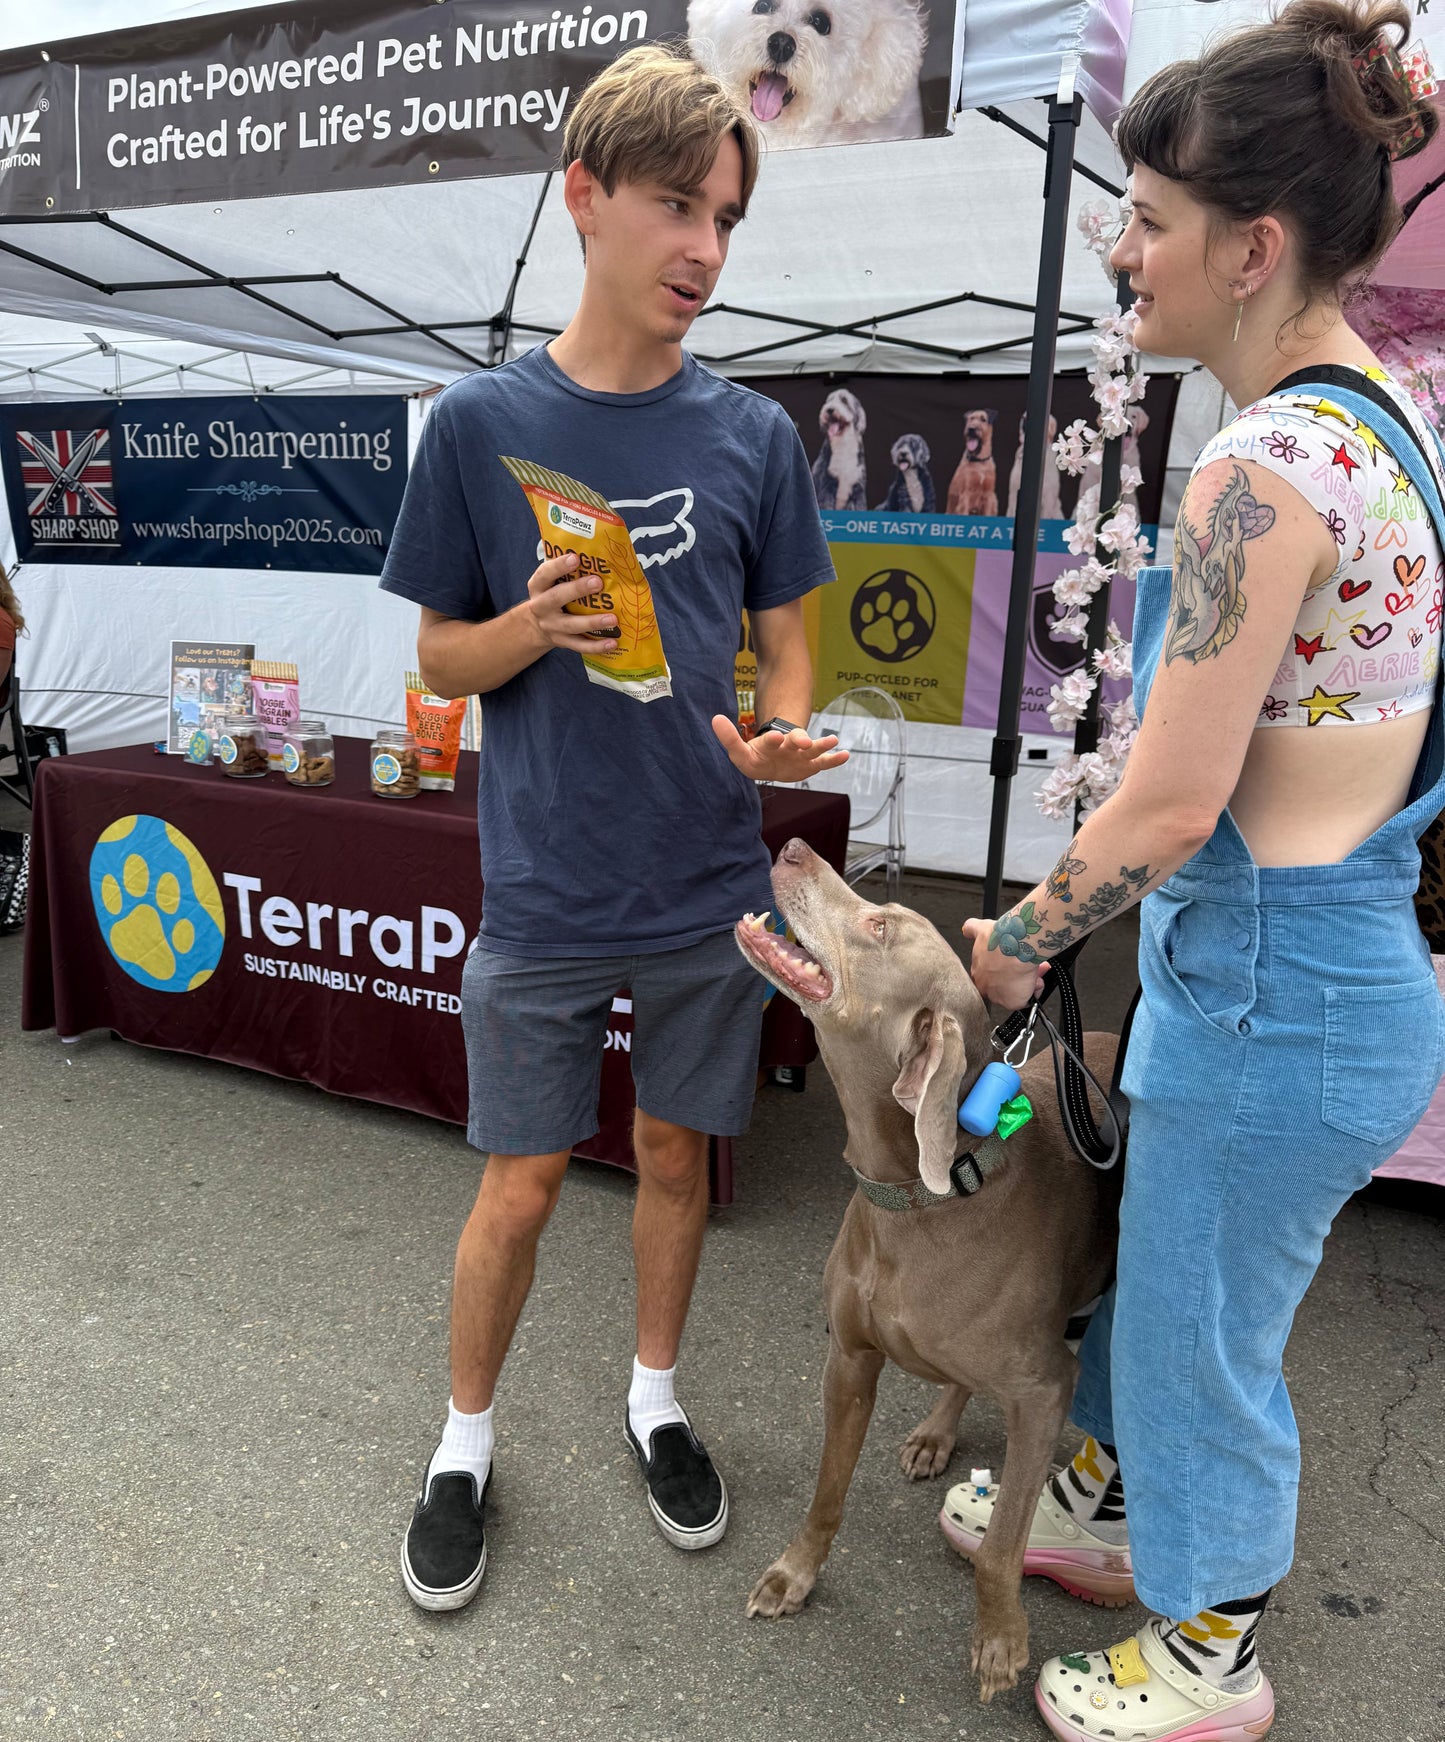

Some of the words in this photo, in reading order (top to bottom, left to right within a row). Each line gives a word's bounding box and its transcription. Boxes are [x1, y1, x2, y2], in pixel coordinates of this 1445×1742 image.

[107, 41, 364, 112] Plant-Powered
[377, 33, 443, 78] Pet
[455, 5, 648, 67] Nutrition
[107, 116, 228, 168] Crafted
[237, 111, 287, 154] for
[299, 104, 391, 149] Life's
[399, 86, 570, 137] Journey
[122, 421, 200, 459] Knife
[208, 420, 392, 472] Sharpening
[132, 515, 382, 548] www.sharpshop2025.com
[562, 511, 593, 531] TerraPawz
[882, 521, 927, 536] TASTY
[930, 525, 964, 538] BITE
[967, 526, 988, 539] AT
[990, 530, 1003, 540] A
[1007, 530, 1046, 542] TE
[837, 671, 911, 686] PUP-CYCLED
[913, 677, 939, 688] FOR
[1324, 651, 1420, 689] AERIE
[415, 710, 450, 724] DOGGIE
[418, 721, 442, 732] BEER
[416, 729, 446, 742] BONES
[244, 952, 367, 994] SUSTAINABLY
[372, 977, 463, 1015] CRAFTED
